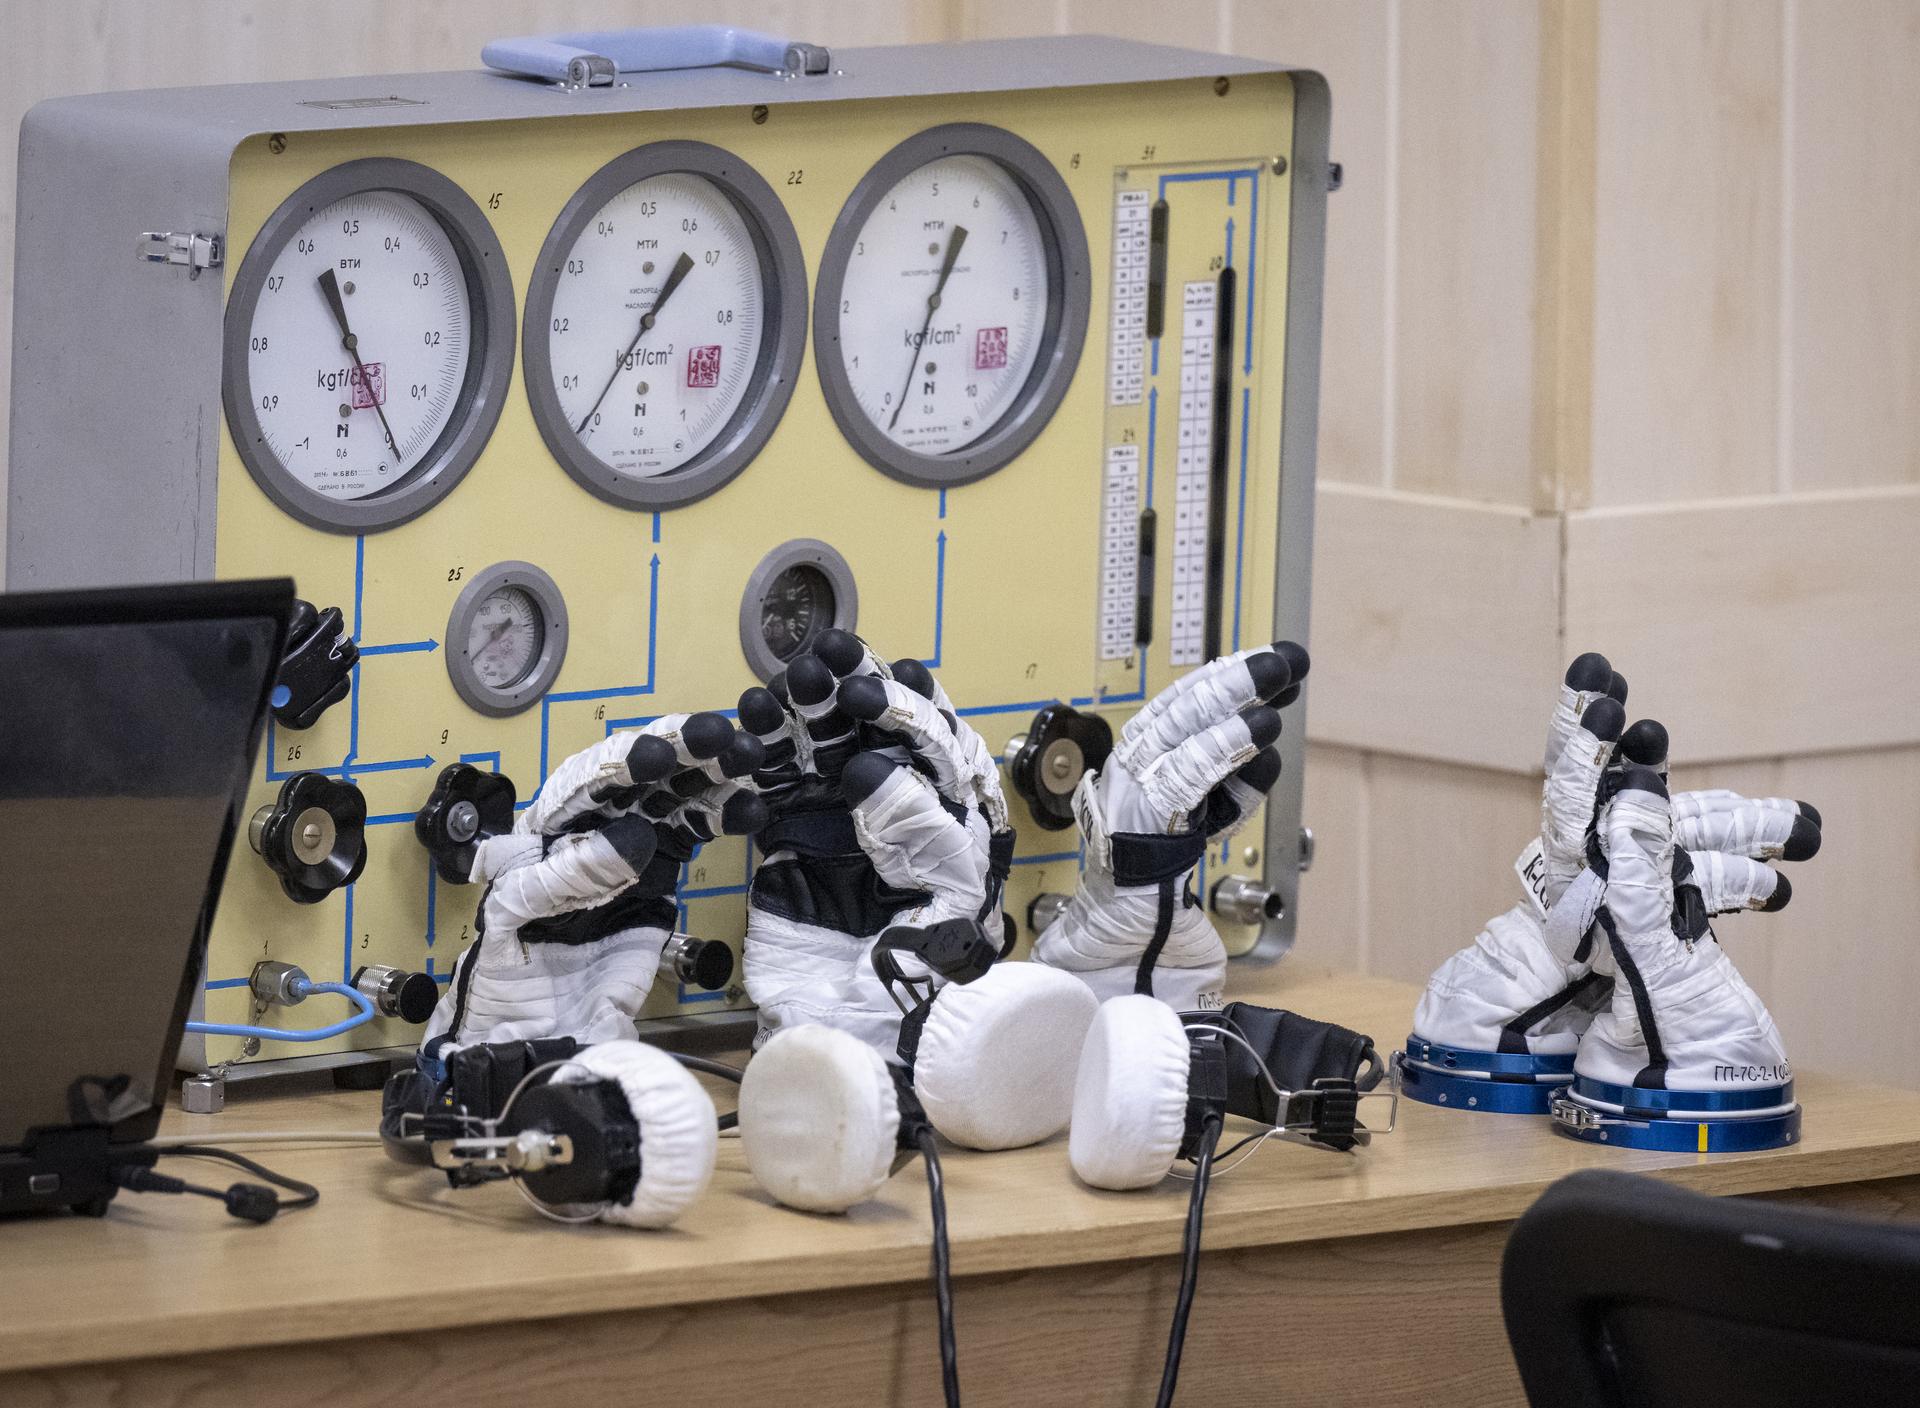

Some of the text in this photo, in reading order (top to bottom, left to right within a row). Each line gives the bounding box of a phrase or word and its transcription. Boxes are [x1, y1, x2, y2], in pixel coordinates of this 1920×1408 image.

[787, 170, 803, 185] 22
[932, 183, 939, 196] 5
[488, 193, 503, 210] 15
[641, 201, 657, 218] 0,5
[889, 200, 897, 212] 4
[973, 195, 980, 208] 6
[343, 220, 359, 237] 0,5
[598, 221, 614, 238] 0,4
[682, 218, 698, 234] 0,6
[384, 237, 400, 253] 0,4
[637, 240, 658, 250] МТИ
[1002, 231, 1008, 244] 7
[298, 239, 314, 255] 0,6
[857, 242, 865, 255] 3
[340, 259, 361, 269] ВТИ
[705, 250, 721, 267] 0,7
[568, 260, 584, 276] 0,3
[268, 276, 284, 293] 0,7
[413, 273, 429, 289] 0,3
[843, 300, 850, 313] 2
[717, 310, 733, 326] 0,8
[553, 319, 569, 334] 0,2
[252, 337, 268, 354] 0,8
[424, 332, 440, 348] 0,2
[853, 356, 859, 368] 1
[563, 375, 578, 391] 0,1
[411, 384, 427, 400] 0,1
[884, 392, 892, 405] 0
[262, 395, 279, 412] 0,9
[594, 413, 601, 426] 0
[680, 409, 686, 421] 1
[336, 448, 348, 460] 0,6
[448, 567, 463, 582] 25
[594, 704, 605, 720] 16
[440, 729, 448, 745] 9
[287, 745, 301, 761] 26
[460, 925, 468, 940] 2
[263, 940, 269, 955] 1
[361, 934, 369, 949] 3
